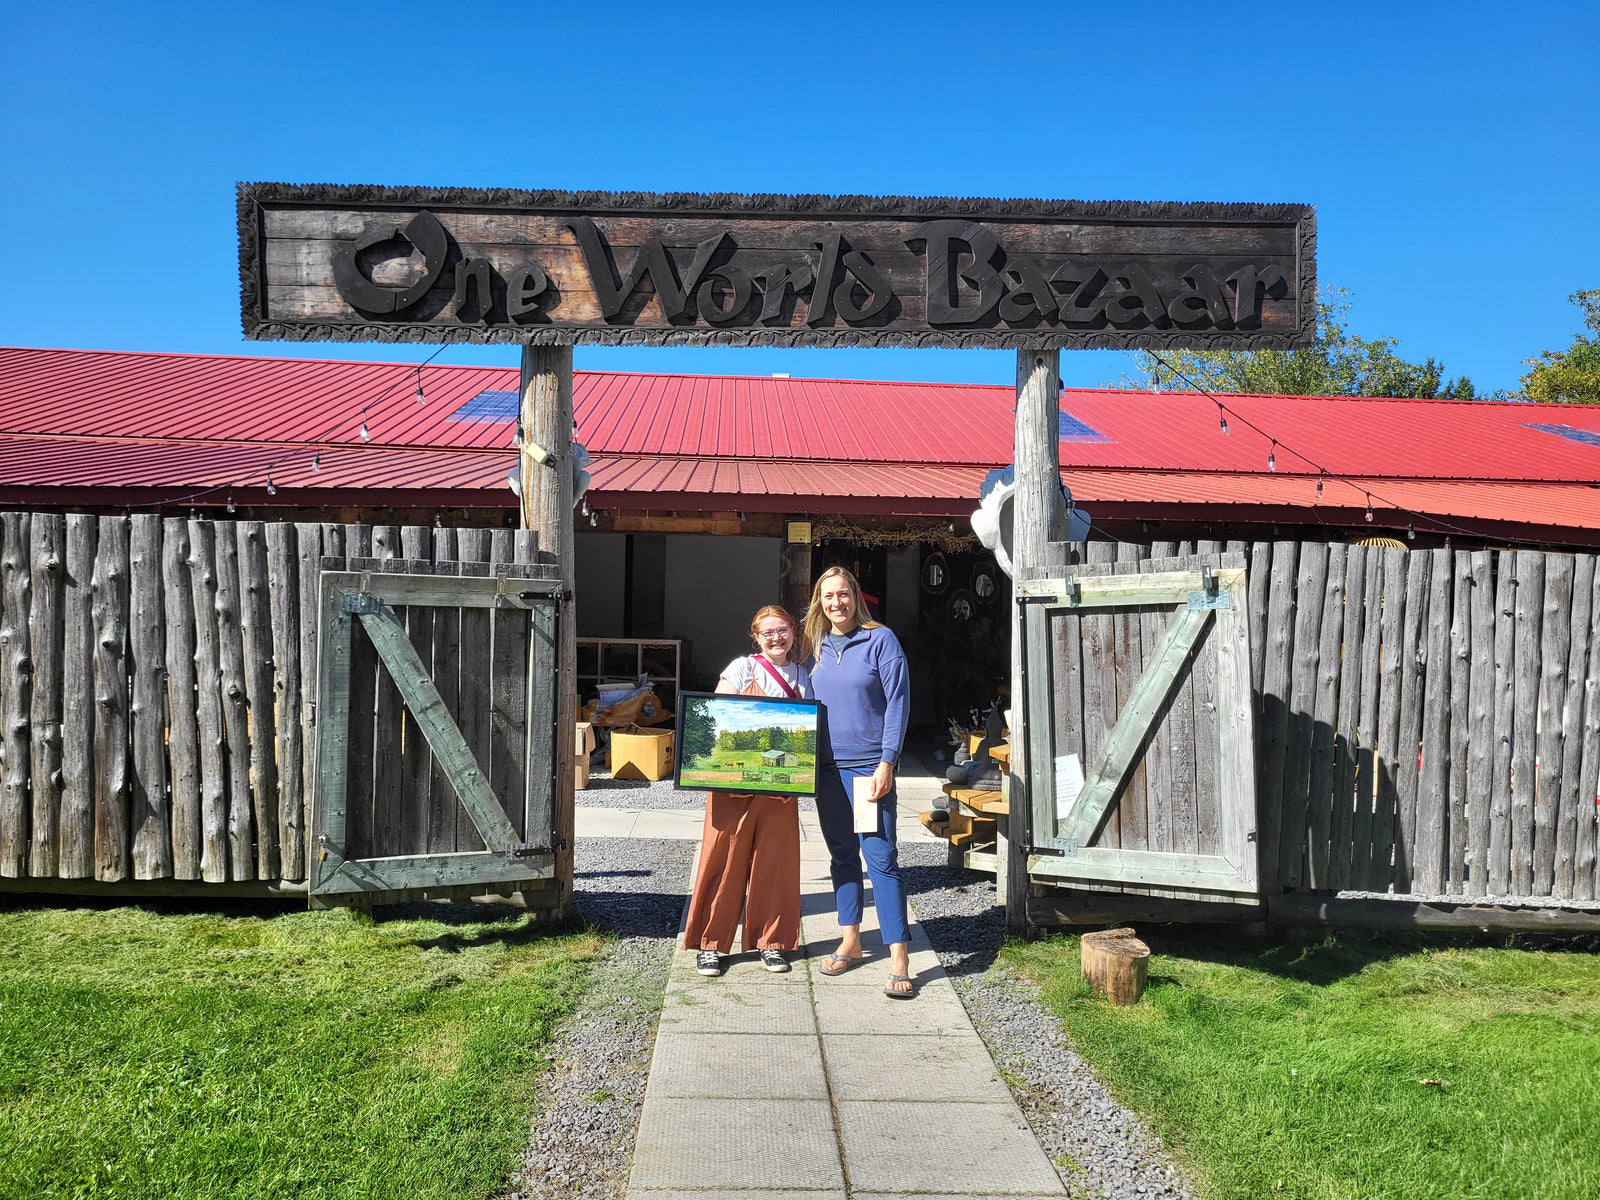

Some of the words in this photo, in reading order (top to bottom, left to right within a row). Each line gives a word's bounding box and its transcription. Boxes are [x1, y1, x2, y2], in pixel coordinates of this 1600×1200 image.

[332, 209, 548, 325] One
[567, 215, 893, 328] World
[905, 218, 1284, 330] Bazaar
